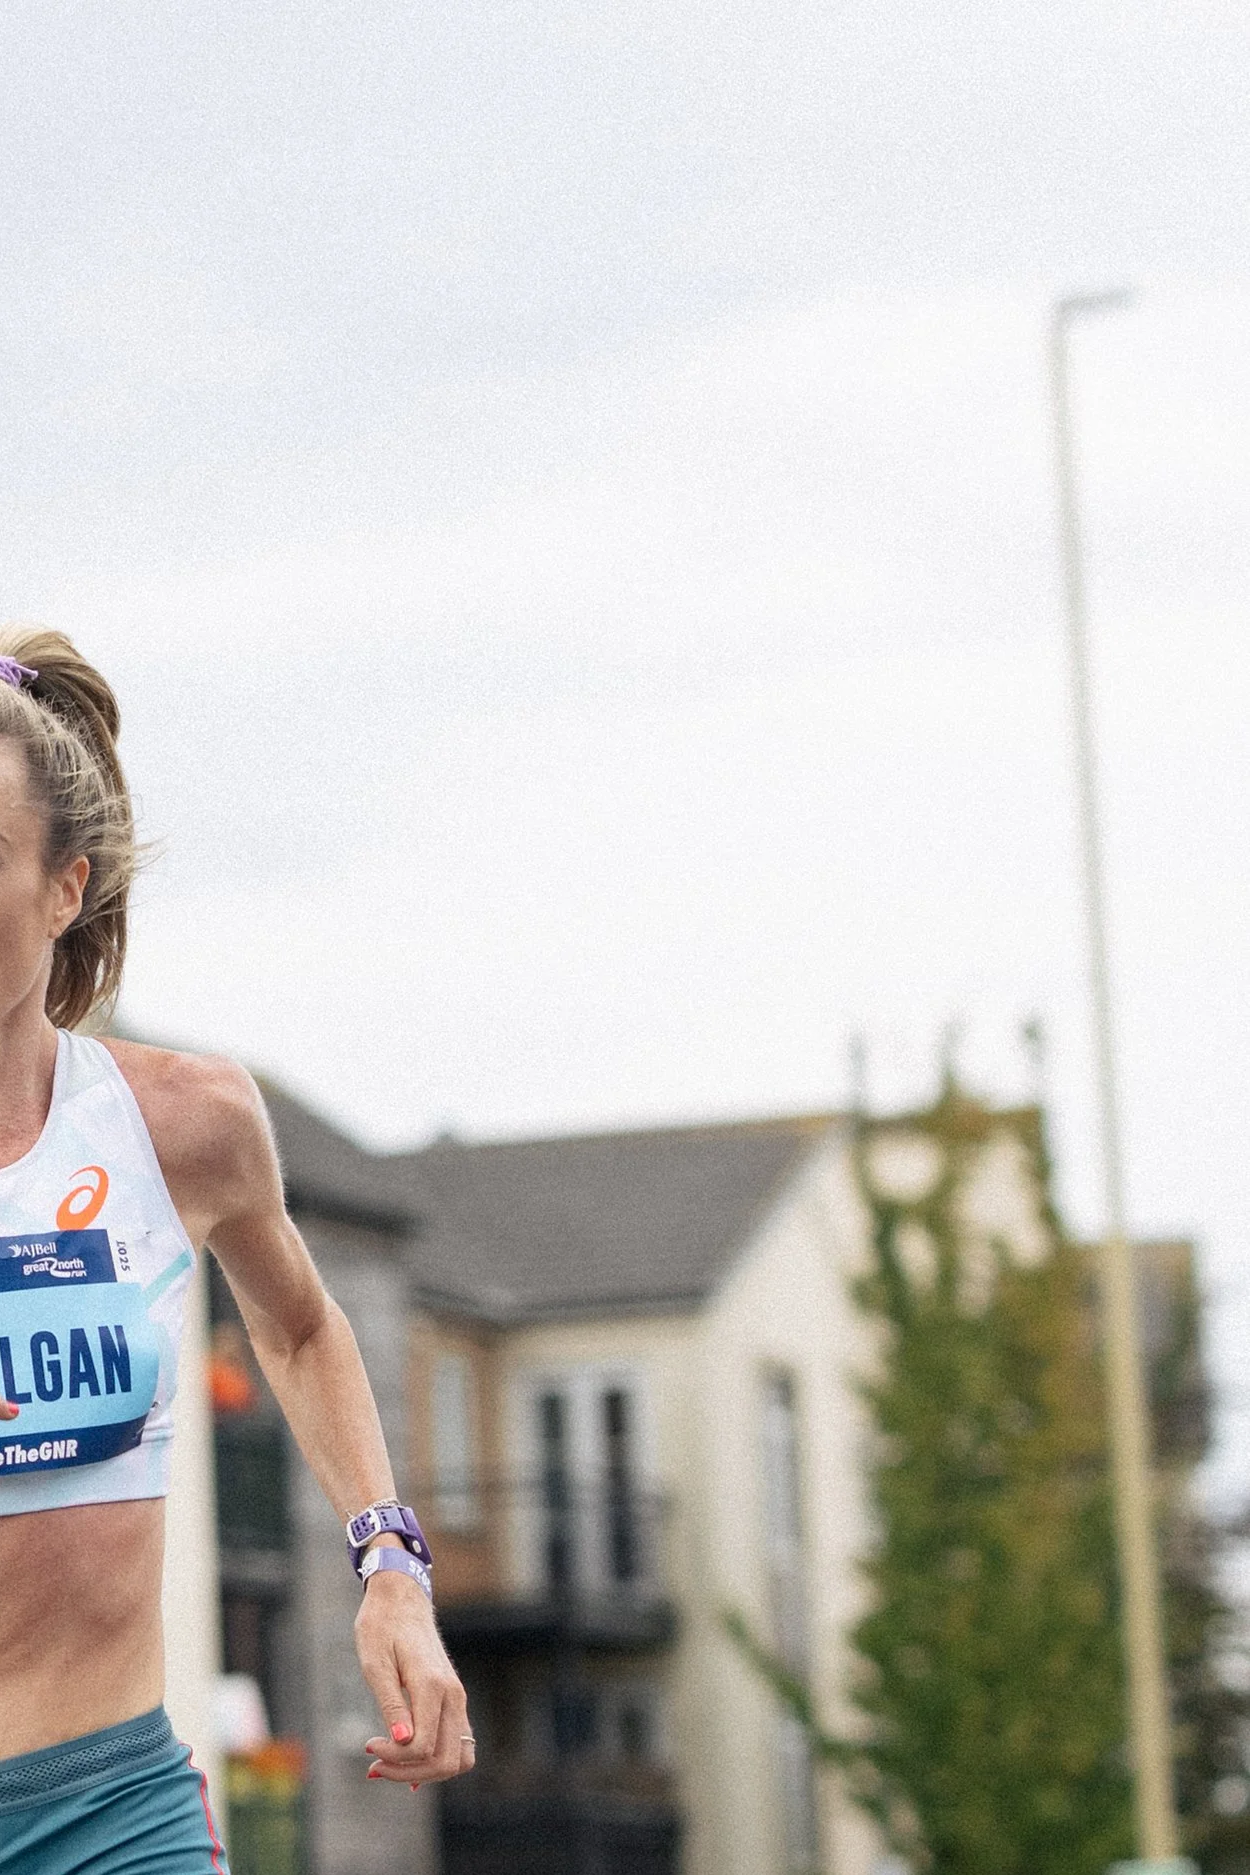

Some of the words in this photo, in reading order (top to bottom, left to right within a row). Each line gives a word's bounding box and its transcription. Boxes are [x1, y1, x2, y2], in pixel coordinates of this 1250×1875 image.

[21, 1242, 57, 1258] AJBell
[23, 1261, 50, 1276] great
[58, 1258, 84, 1270] north
[70, 1270, 88, 1278] run
